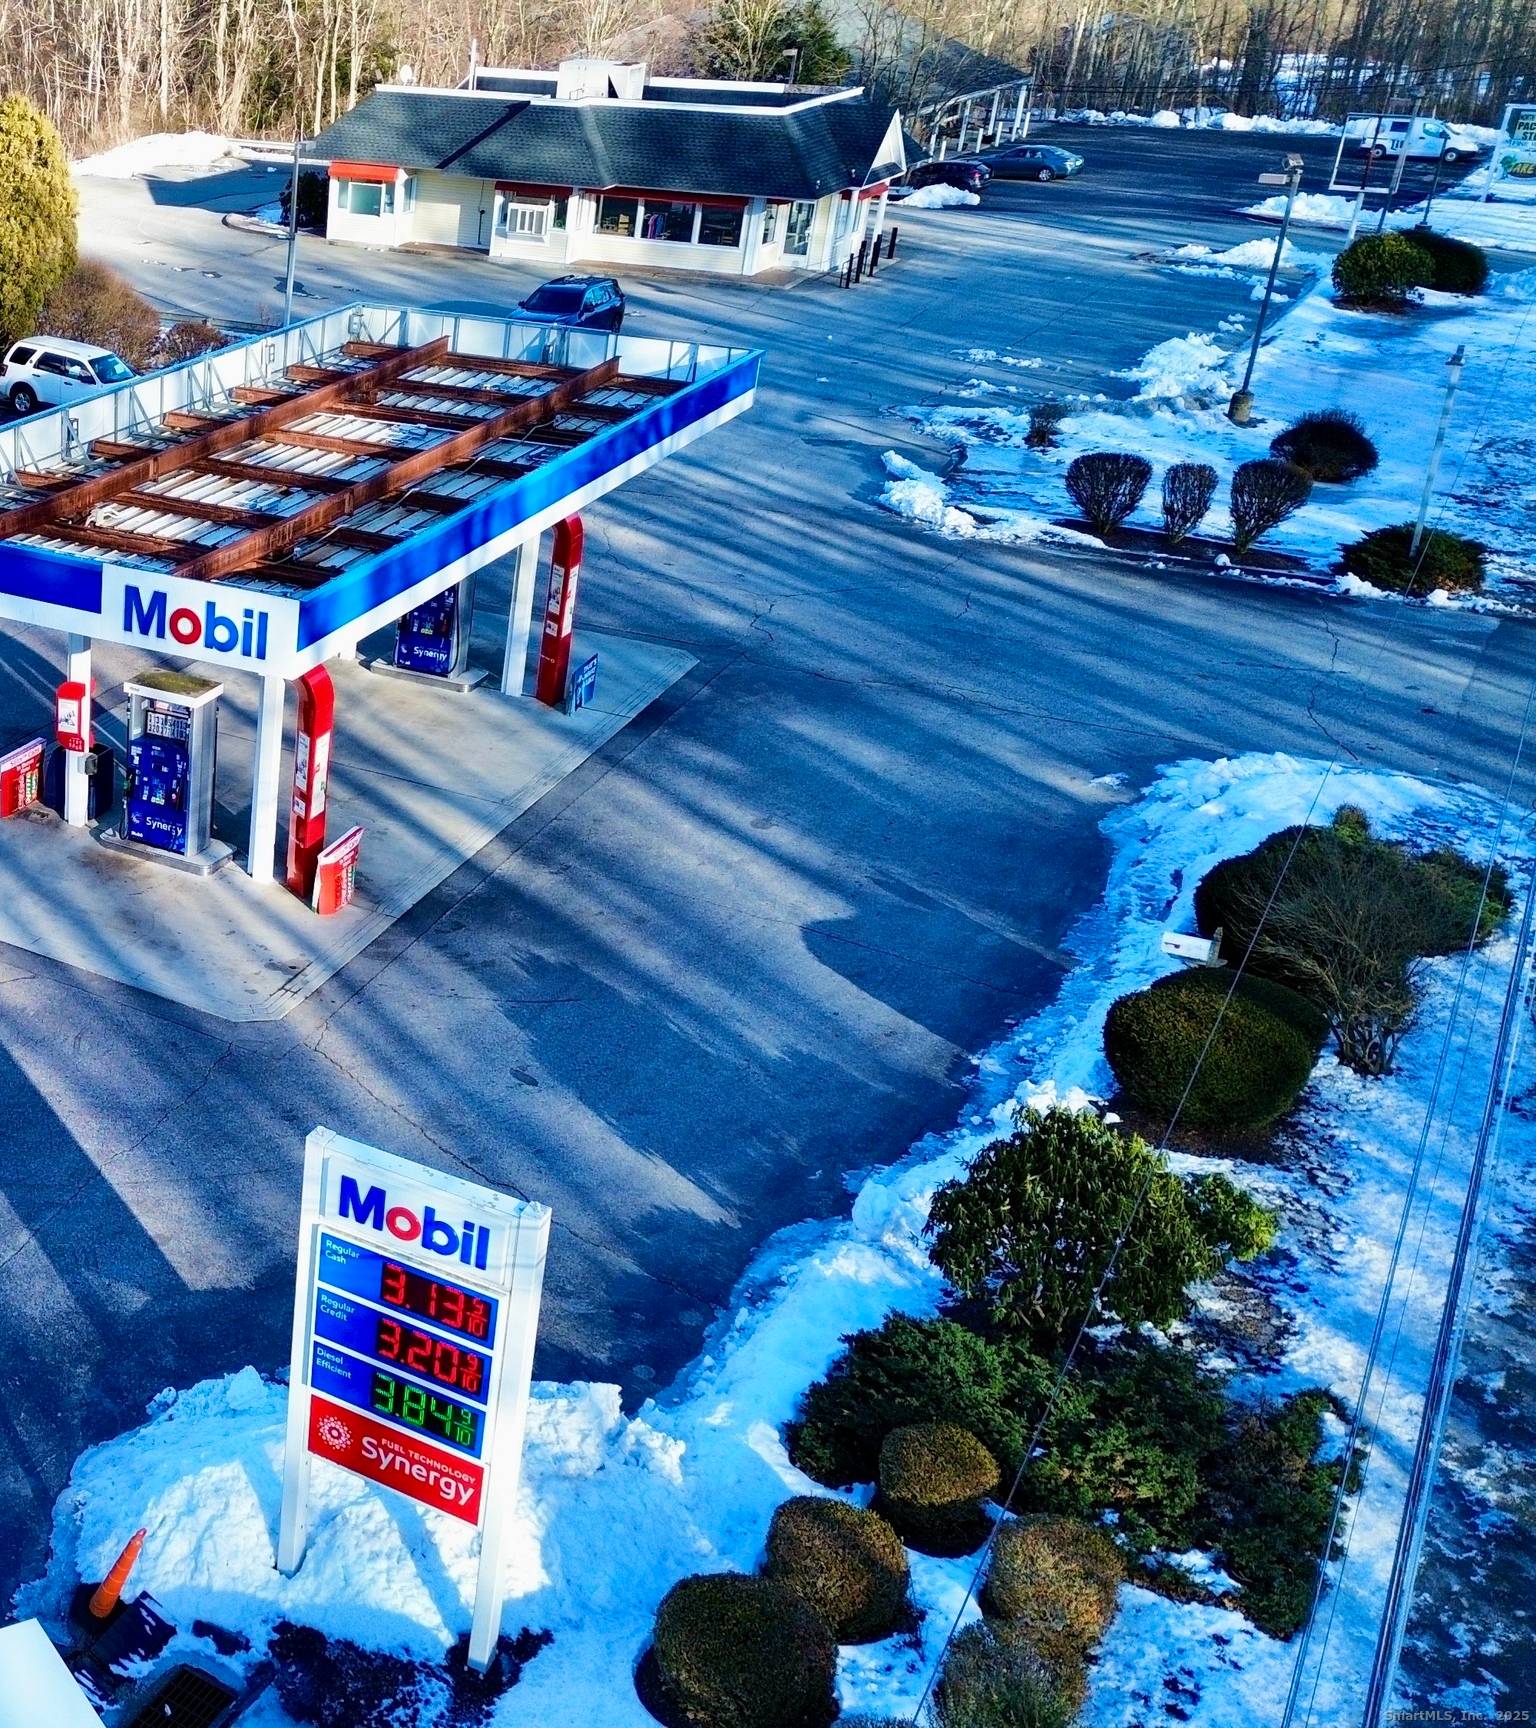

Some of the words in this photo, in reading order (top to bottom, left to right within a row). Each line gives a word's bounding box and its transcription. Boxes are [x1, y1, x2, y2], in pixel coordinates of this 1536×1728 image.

[123, 584, 268, 660] Mobil
[146, 816, 183, 837] Synergy
[339, 1174, 490, 1270] Mobil
[325, 1239, 360, 1259] Regular
[325, 1251, 347, 1265] Cash
[320, 1294, 356, 1314] Regular
[320, 1304, 347, 1322] Credit
[316, 1347, 344, 1365] Diesel
[315, 1358, 352, 1380] Efficient
[361, 1436, 475, 1506] Synergy
[381, 1438, 405, 1455] FUEL
[408, 1450, 476, 1486] TECHNOLOGY
